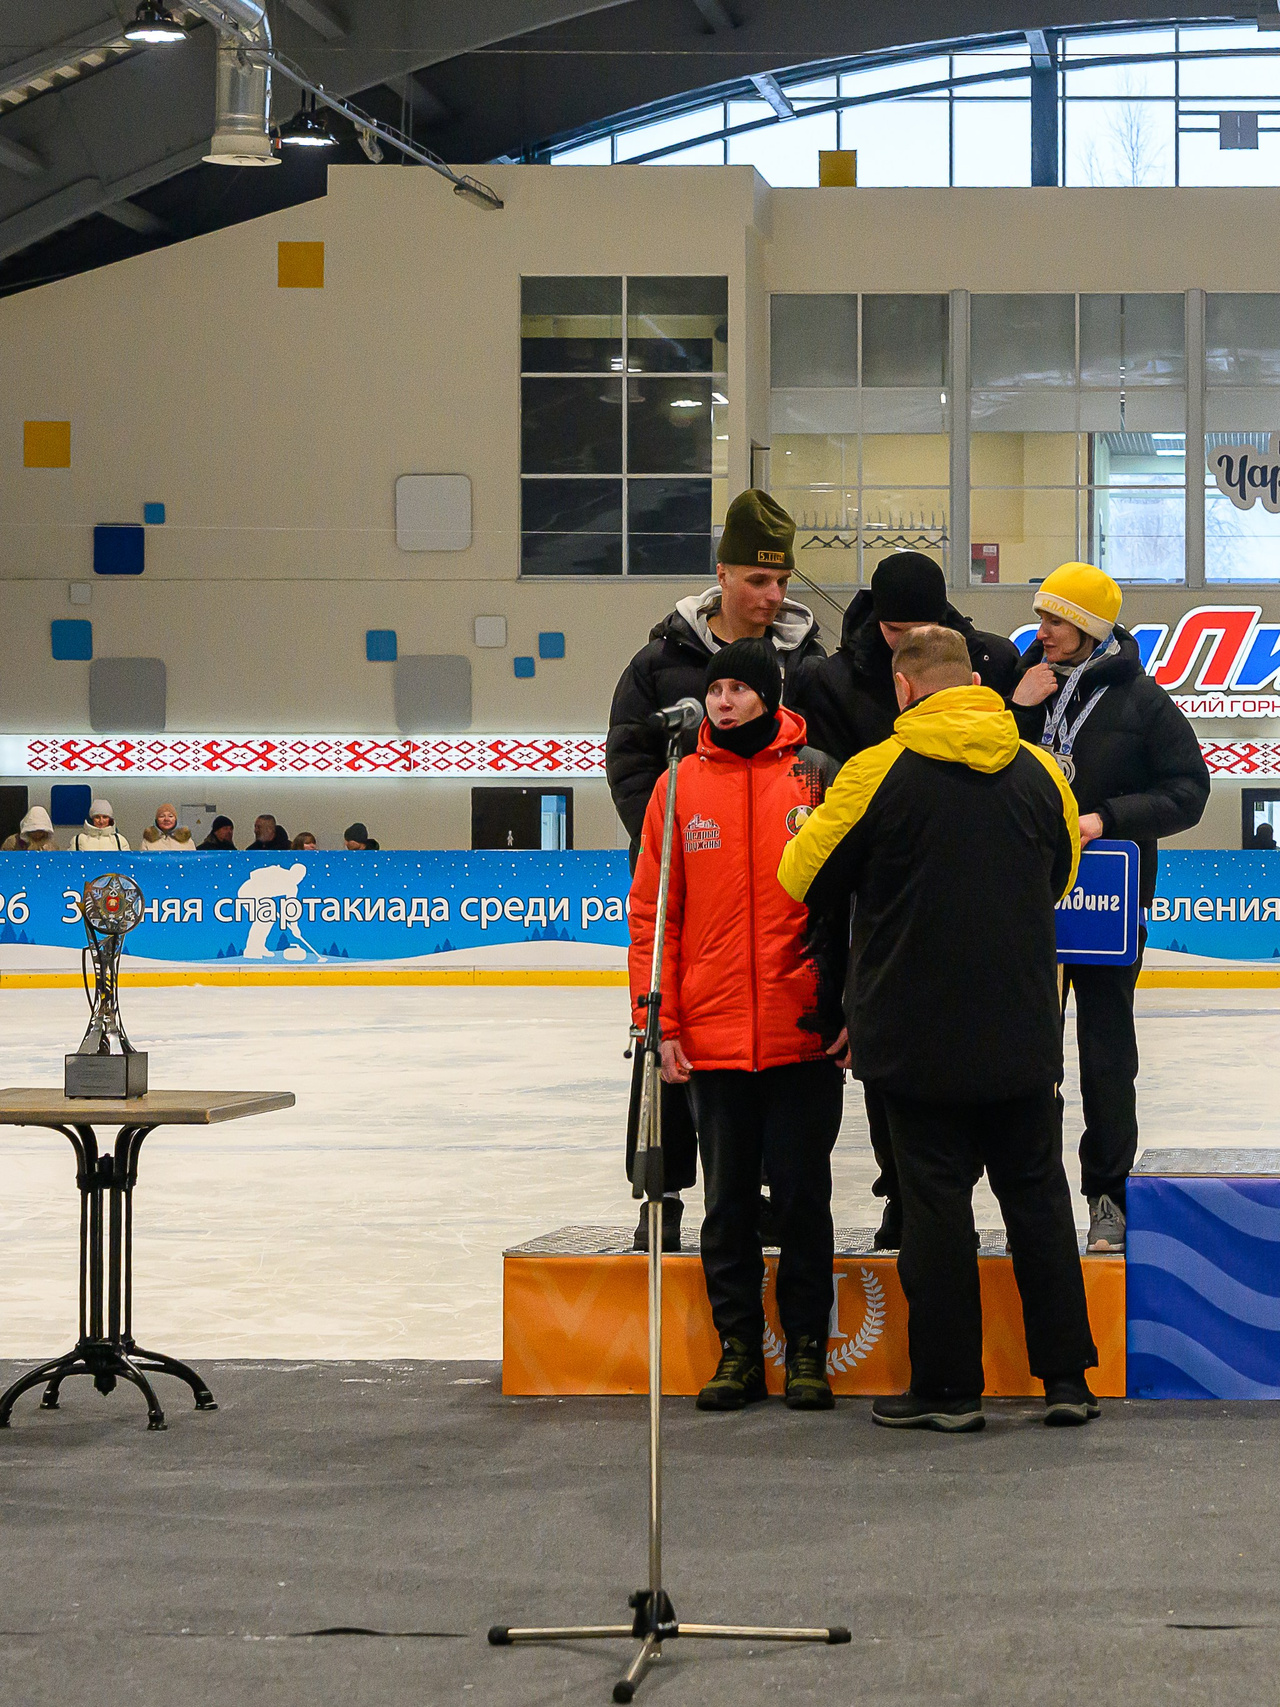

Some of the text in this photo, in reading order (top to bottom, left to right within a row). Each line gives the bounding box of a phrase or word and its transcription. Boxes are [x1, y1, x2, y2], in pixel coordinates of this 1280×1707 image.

[1176, 696, 1223, 713] КИЙ
[61, 890, 204, 924] Зняя
[213, 896, 449, 930] спартакиада
[459, 896, 569, 930] среди
[581, 896, 630, 930] ра
